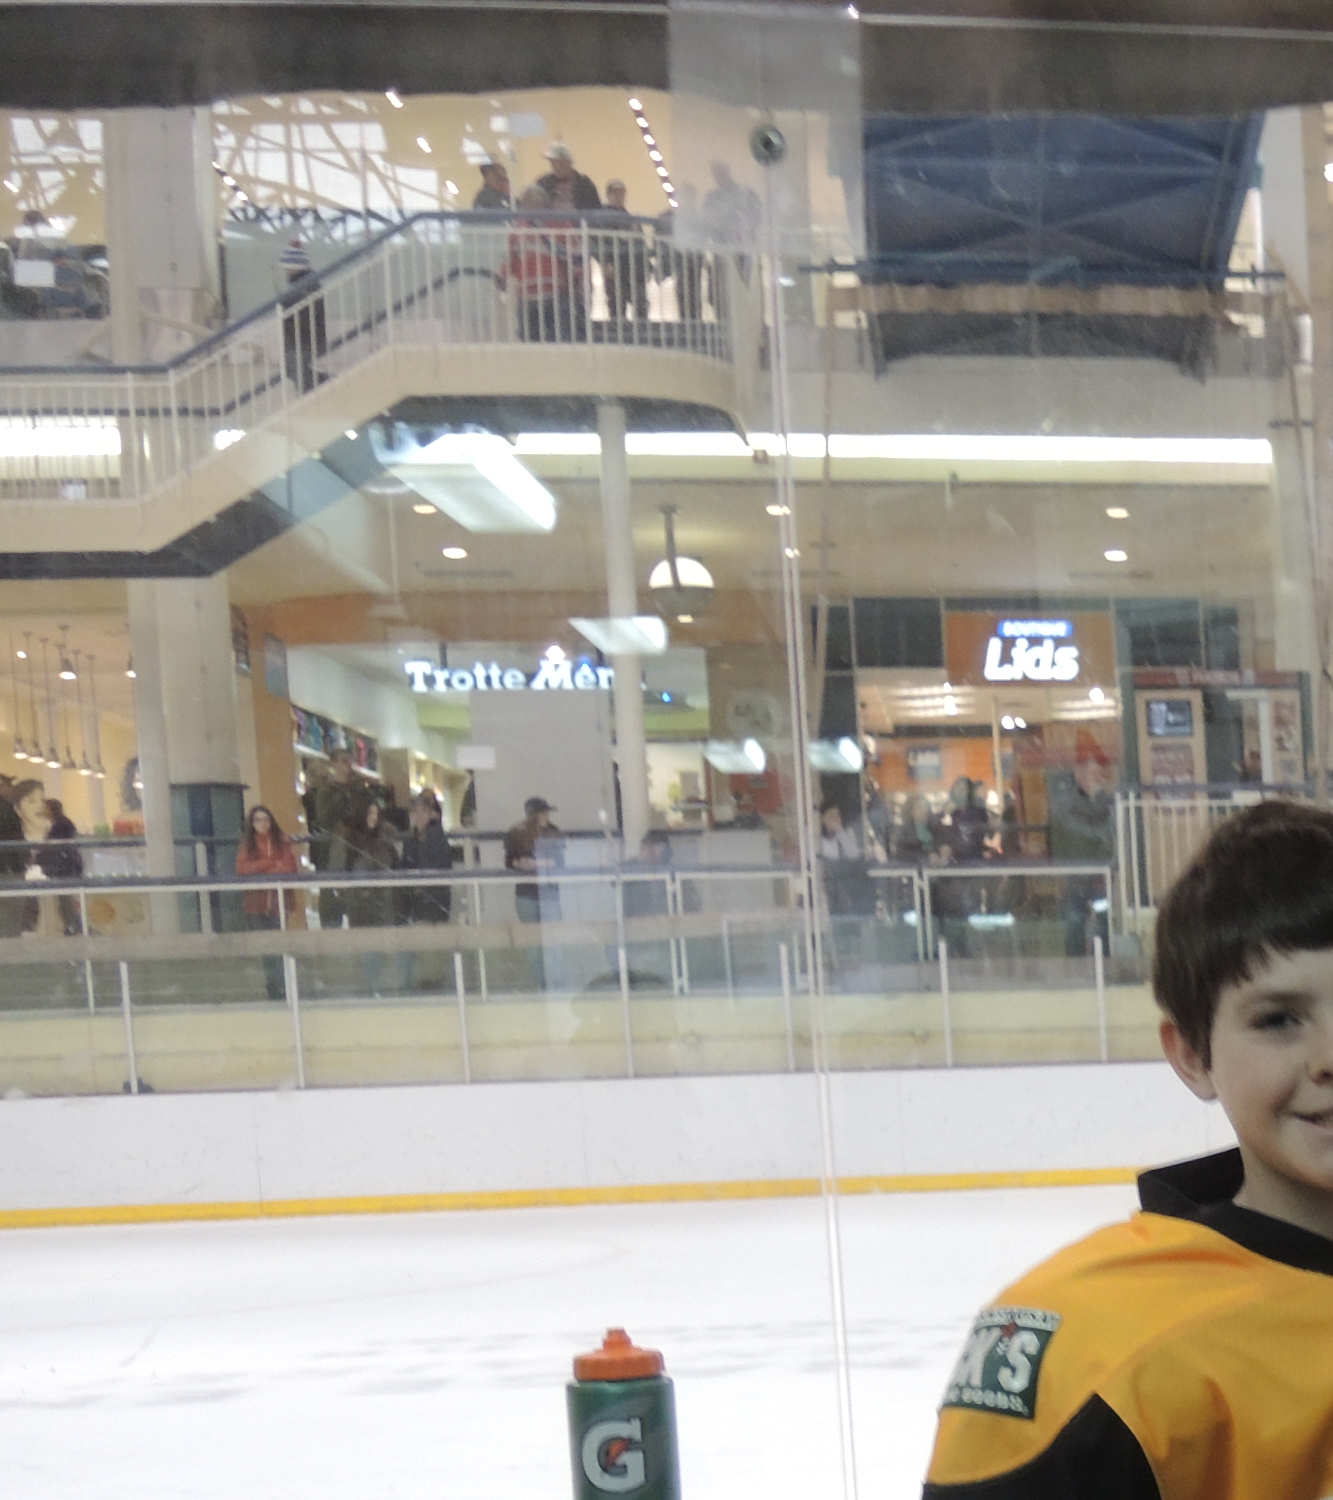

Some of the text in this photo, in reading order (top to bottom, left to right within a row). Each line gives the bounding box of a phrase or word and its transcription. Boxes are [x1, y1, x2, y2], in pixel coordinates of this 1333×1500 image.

[404, 660, 527, 692] Trotte
[984, 637, 1079, 681] Lids
[581, 1417, 647, 1493] G
